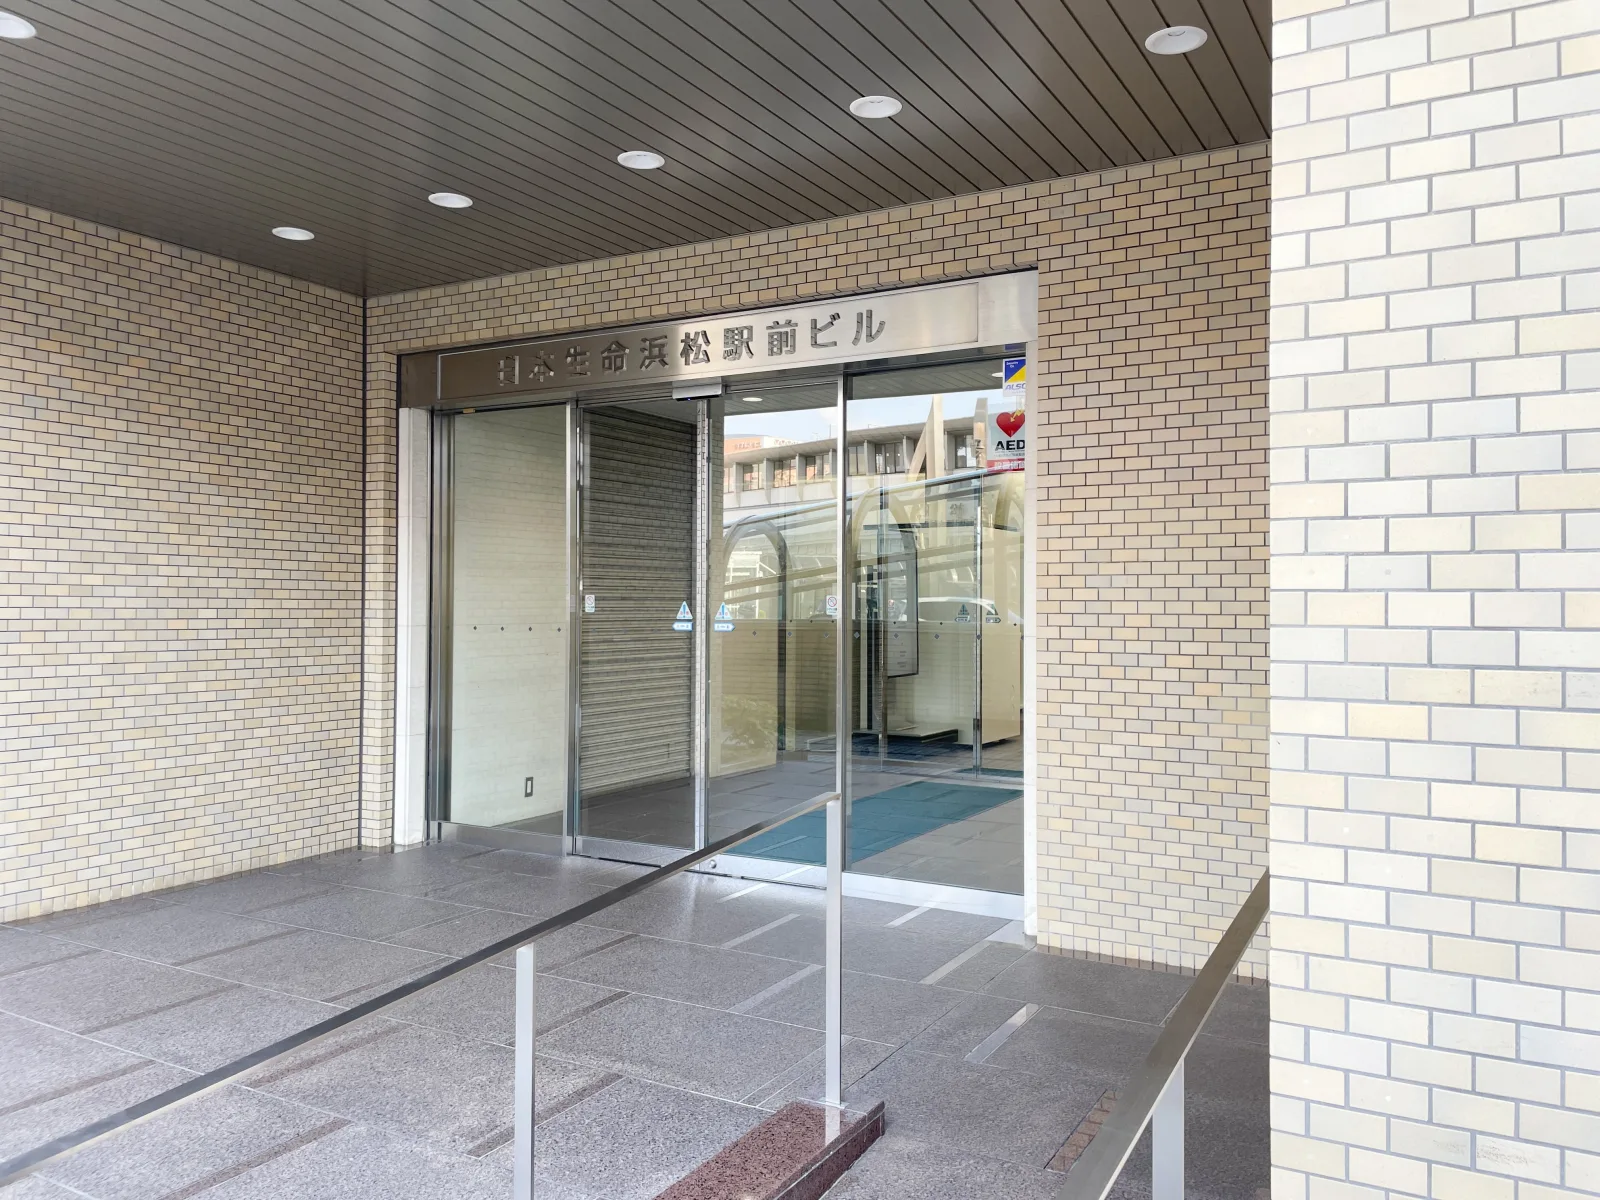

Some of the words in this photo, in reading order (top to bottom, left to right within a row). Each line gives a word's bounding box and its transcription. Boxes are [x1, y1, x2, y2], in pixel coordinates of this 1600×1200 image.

[498, 310, 886, 385] 日本生命浜松駅前ビル
[995, 440, 1025, 450] AED
